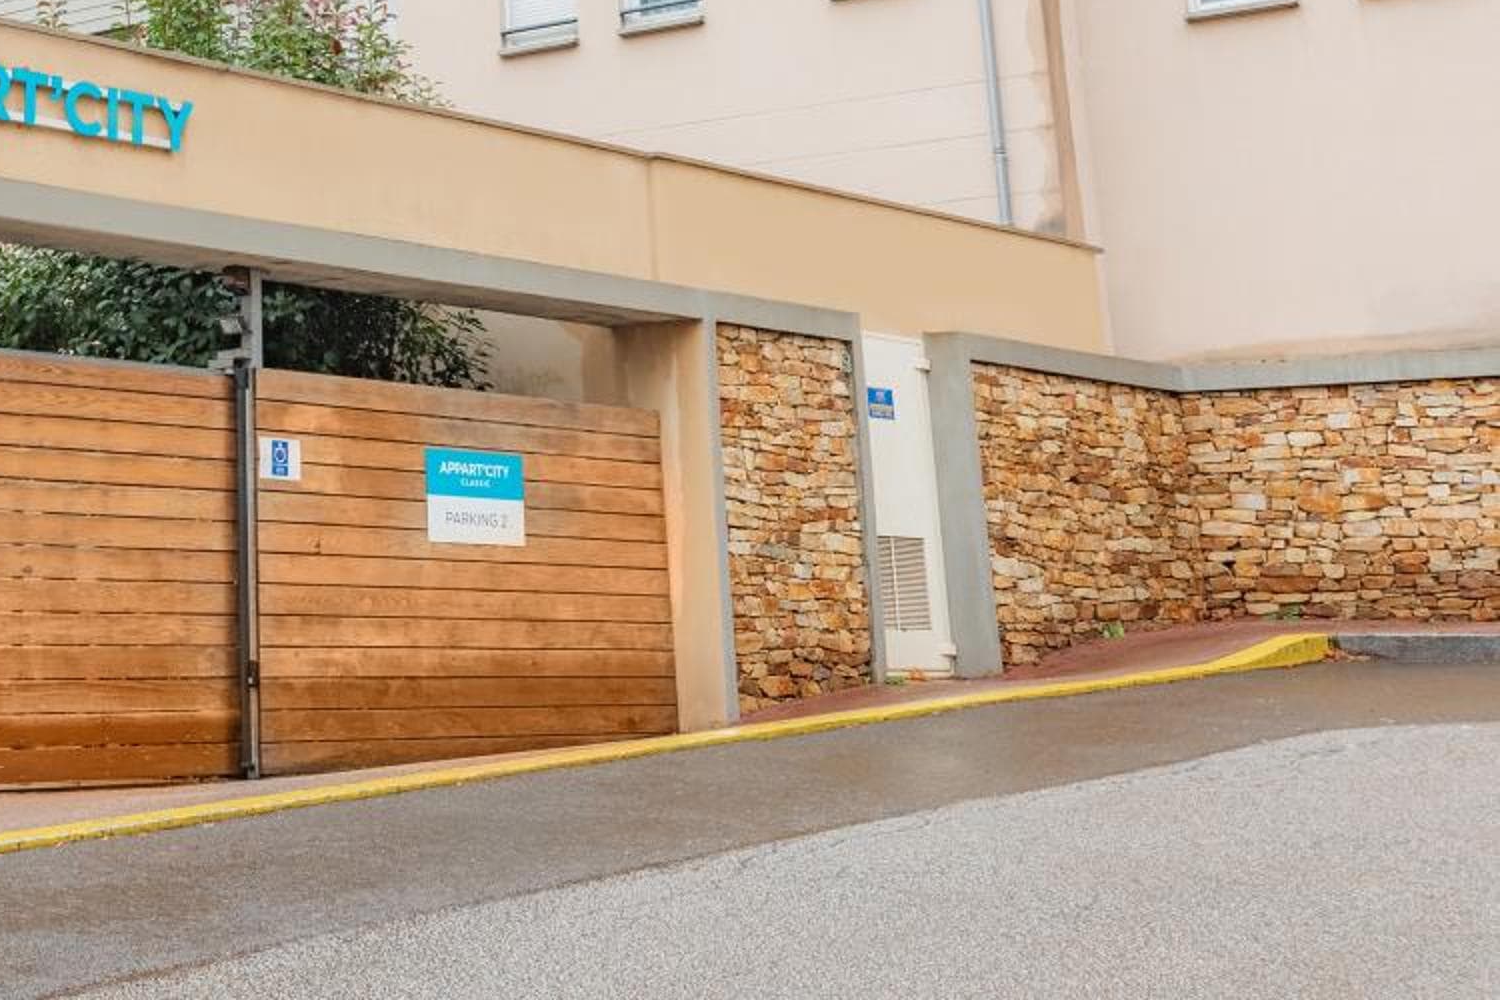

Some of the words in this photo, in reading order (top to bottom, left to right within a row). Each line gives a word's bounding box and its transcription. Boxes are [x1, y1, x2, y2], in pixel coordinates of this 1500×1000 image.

[439, 461, 509, 478] APPART'CITY
[445, 511, 498, 529] PARKING
[500, 514, 508, 529] 2
